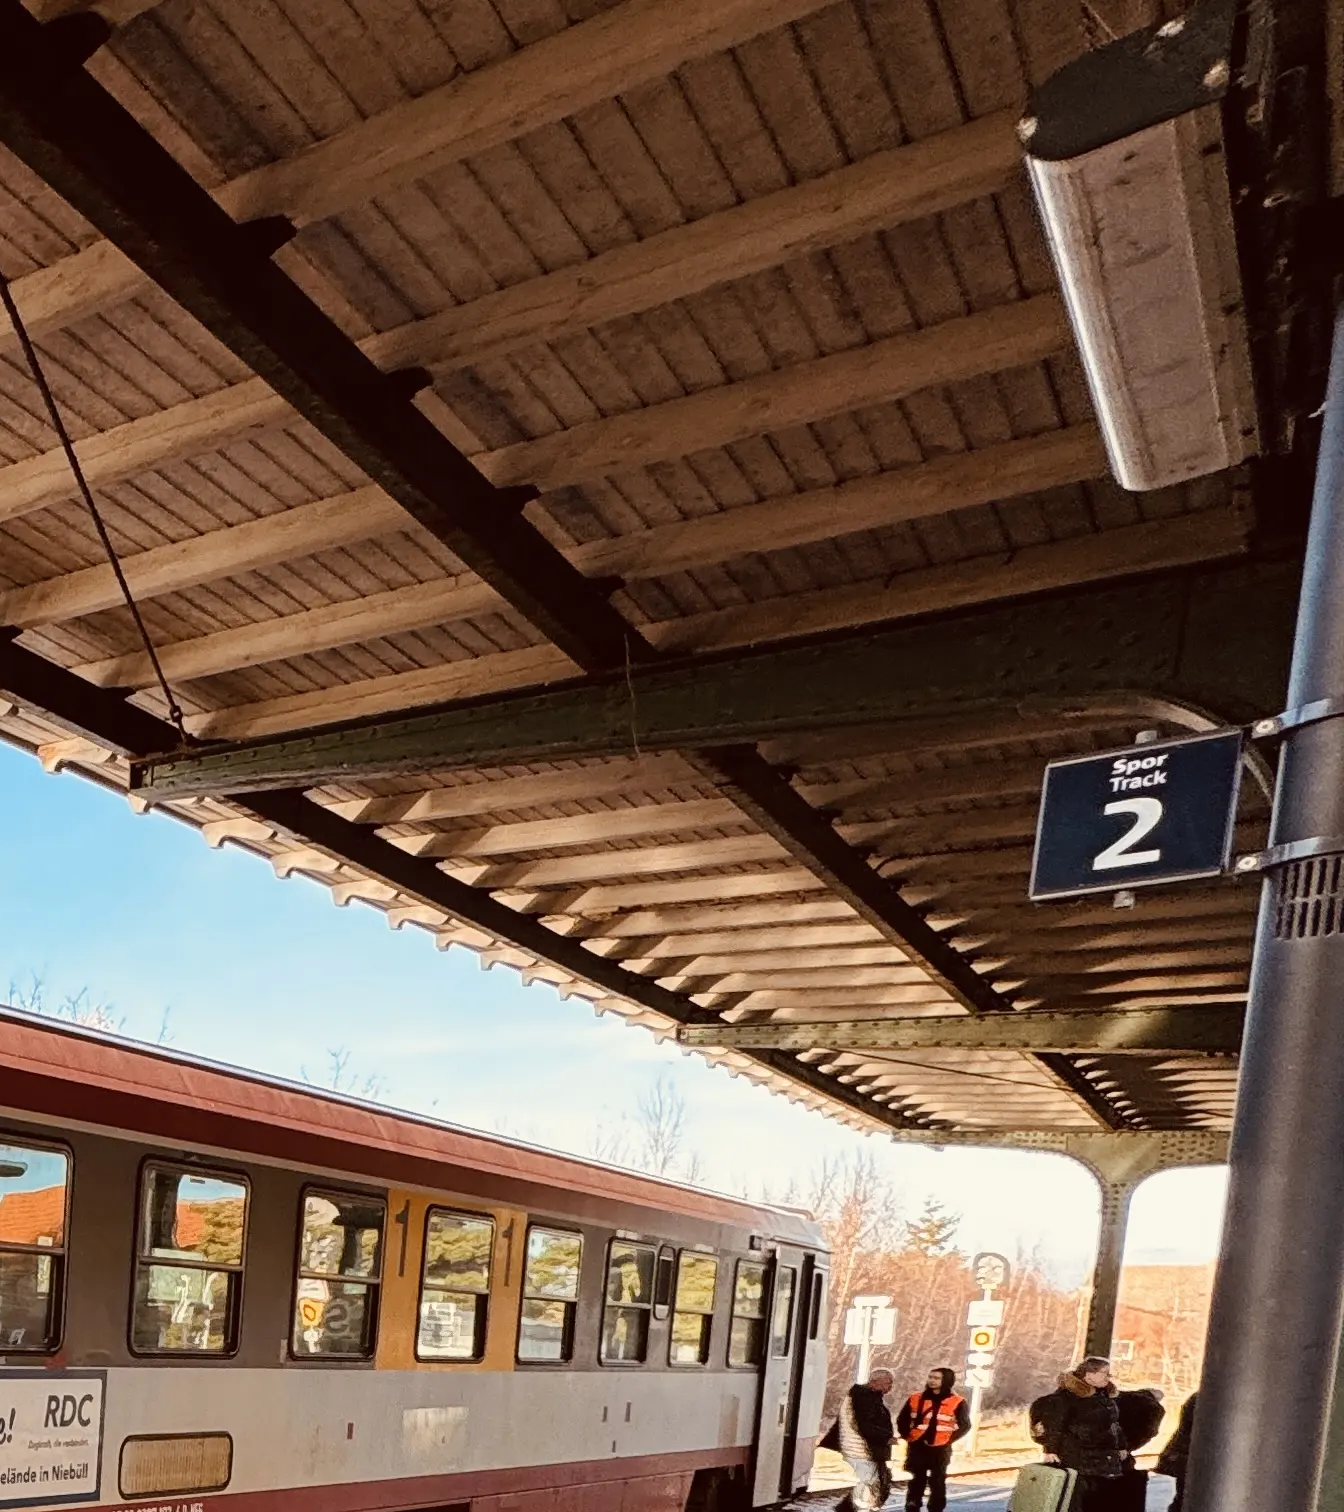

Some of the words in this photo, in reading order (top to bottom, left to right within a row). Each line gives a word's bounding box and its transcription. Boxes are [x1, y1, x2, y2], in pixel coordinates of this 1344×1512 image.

[1109, 770, 1168, 792] Track
[1112, 753, 1169, 775] Spor
[1092, 797, 1163, 870] 2
[395, 1199, 410, 1277] 1
[502, 1217, 515, 1287] 1
[44, 1393, 94, 1428] RDC
[39, 1465, 49, 1482] in
[52, 1462, 89, 1481] Niebüll
